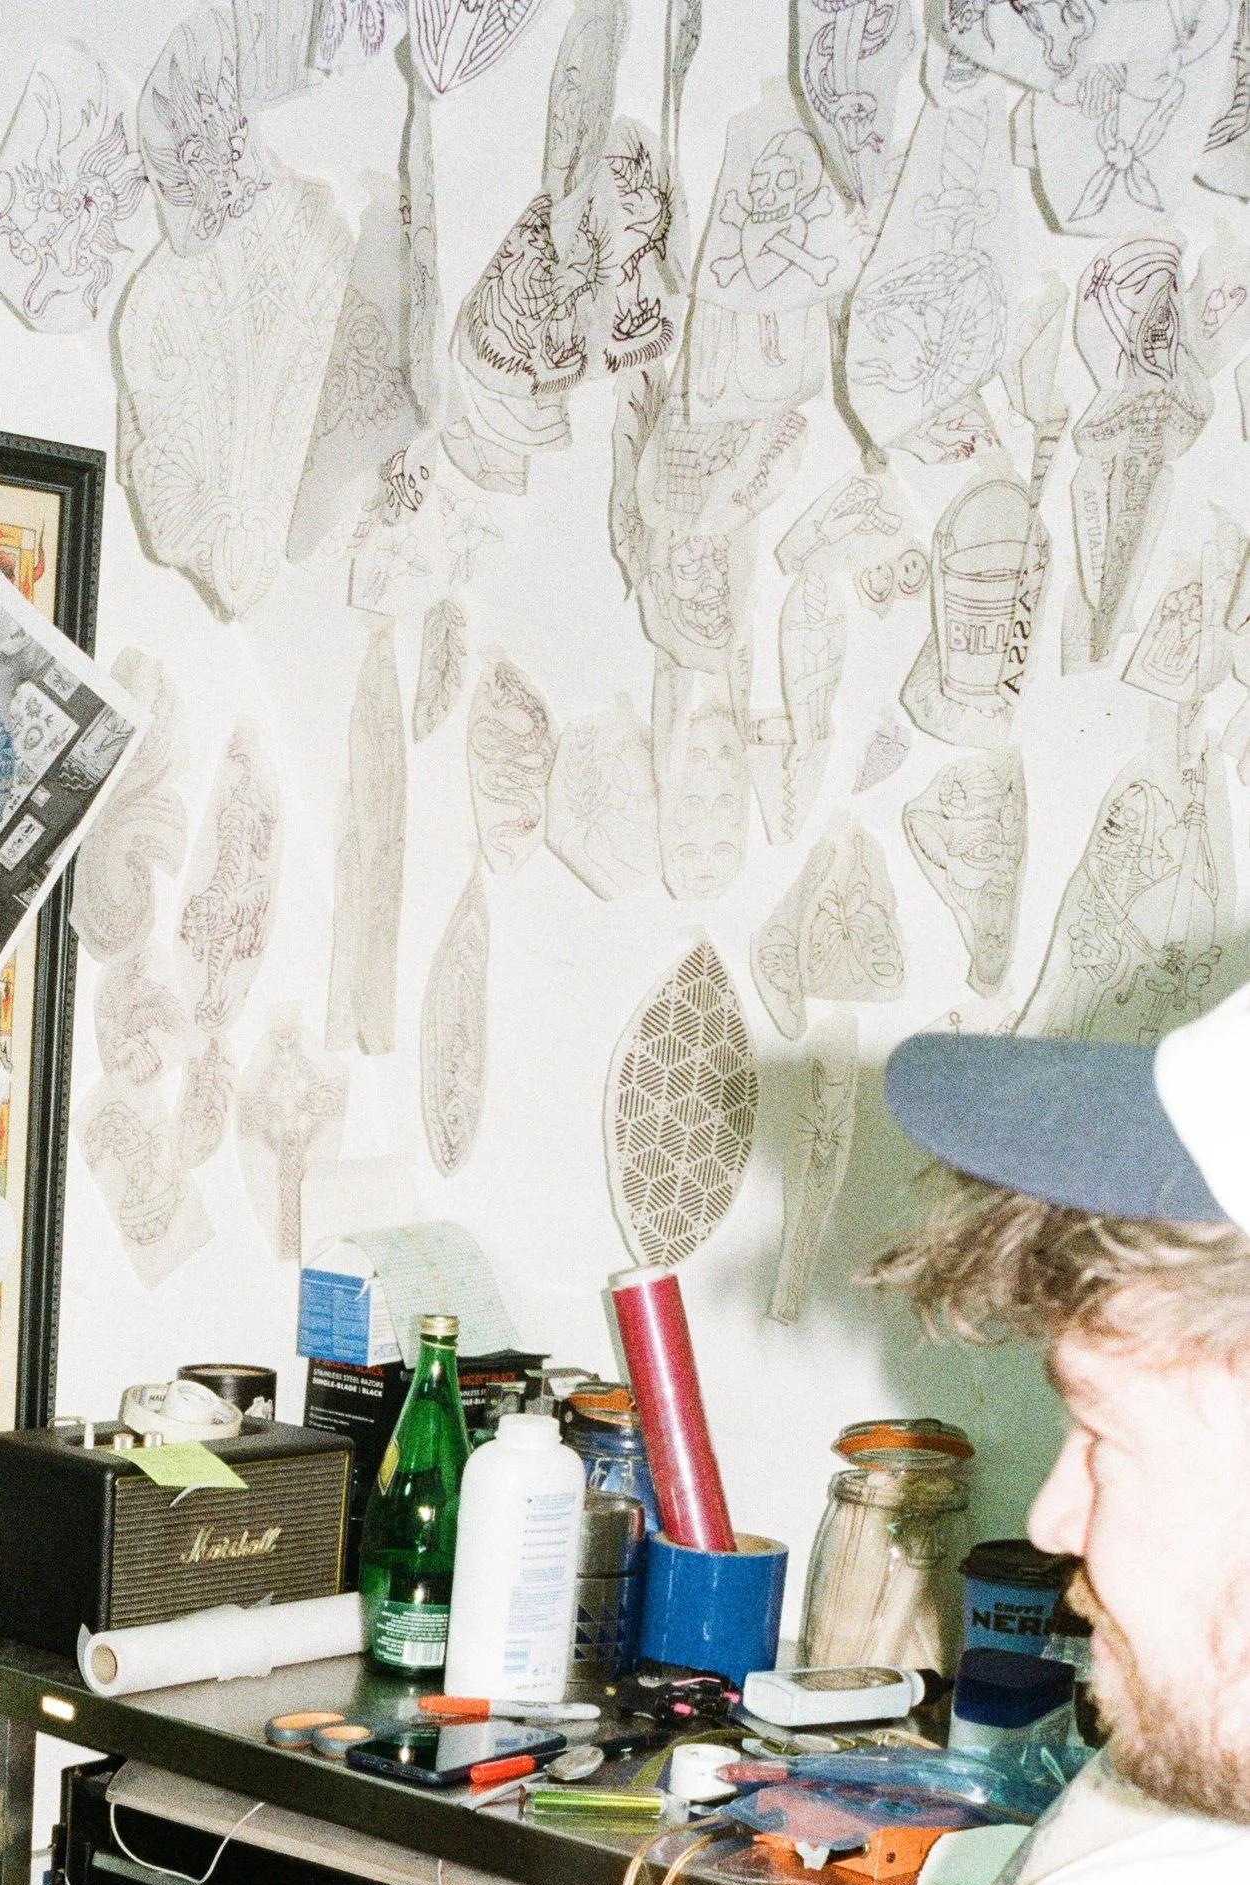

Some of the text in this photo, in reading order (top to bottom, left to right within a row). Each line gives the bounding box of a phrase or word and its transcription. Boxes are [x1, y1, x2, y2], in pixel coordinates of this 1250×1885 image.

[312, 1377, 383, 1398] SINGLE-BLADE BLACK
[313, 1368, 384, 1389] STAINLESS STEEL RAZORS
[180, 1525, 283, 1564] Marshall
